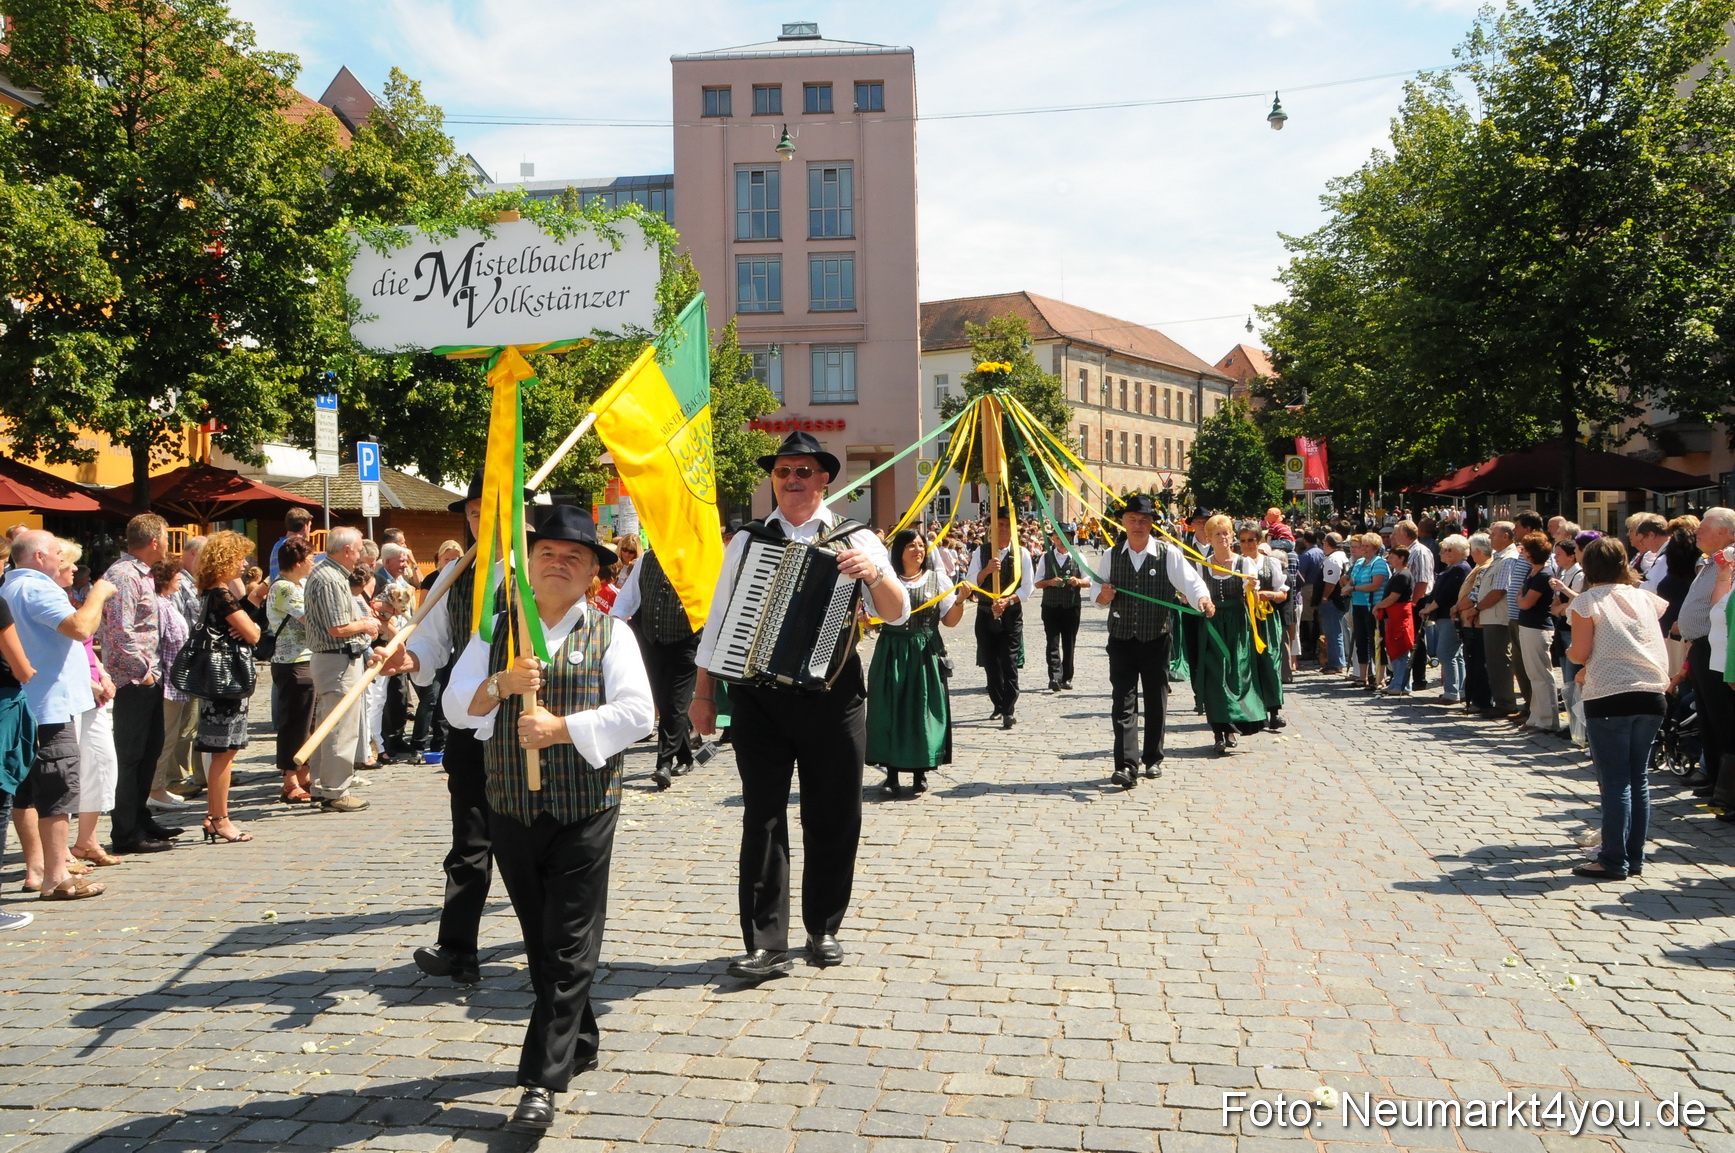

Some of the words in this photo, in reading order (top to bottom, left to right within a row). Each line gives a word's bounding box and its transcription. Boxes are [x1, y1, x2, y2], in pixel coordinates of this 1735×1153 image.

[372, 267, 410, 297] die
[412, 241, 613, 302] Mistelbacher
[452, 276, 630, 329] Volkstänzer
[659, 388, 707, 437] MISTELBACH
[749, 416, 846, 433] Sparkasse
[362, 447, 375, 477] P
[796, 556, 812, 593] HOHNER
